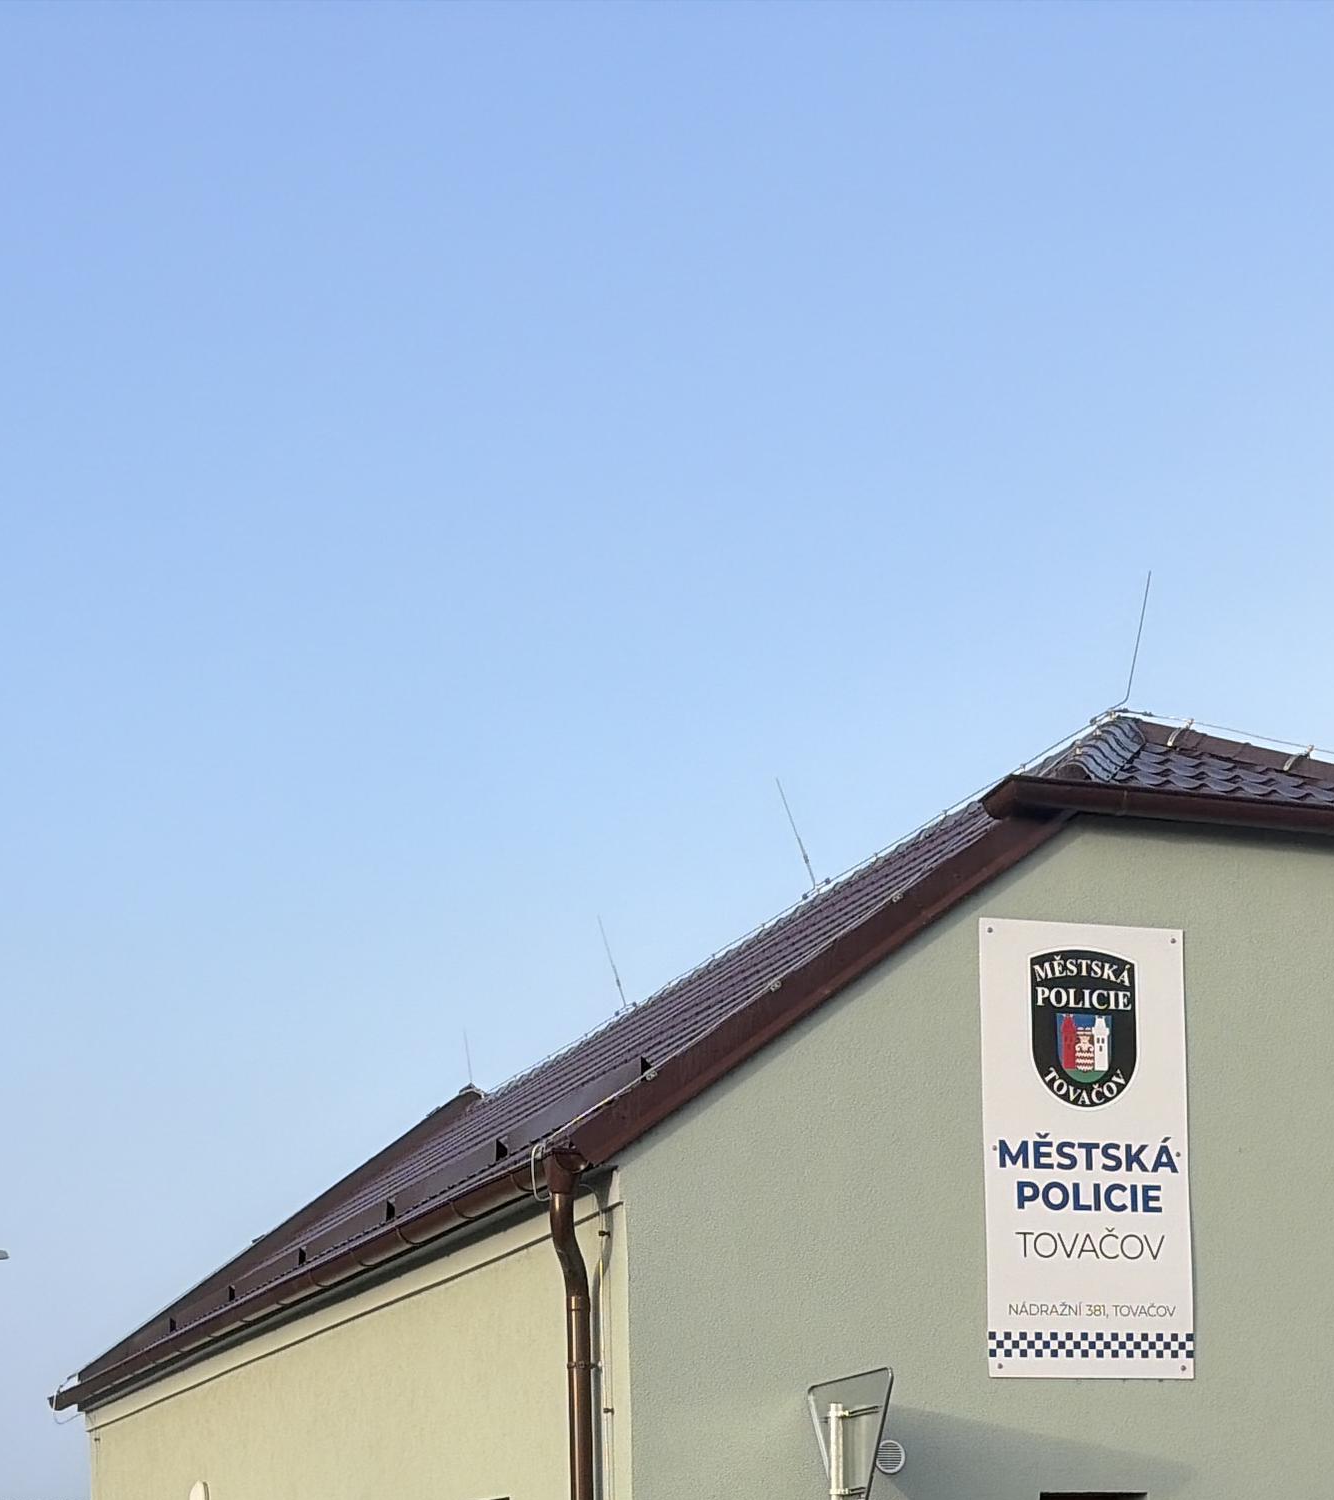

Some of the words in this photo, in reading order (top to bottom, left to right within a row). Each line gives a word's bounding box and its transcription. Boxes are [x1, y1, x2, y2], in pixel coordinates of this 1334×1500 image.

[1033, 955, 1131, 986] MĚSTSKÁ
[1035, 987, 1132, 1010] POLICIE
[1044, 1067, 1127, 1105] TOVAČOV
[998, 1132, 1179, 1173] MĚSTSKÁ
[1017, 1181, 1163, 1213] POLICIE
[1015, 1227, 1165, 1260] TOVAČOV
[1008, 1301, 1082, 1317] NÁDRAŽNÍ
[1085, 1304, 1109, 1319] 381,
[1113, 1303, 1177, 1318] TOVAČOV
